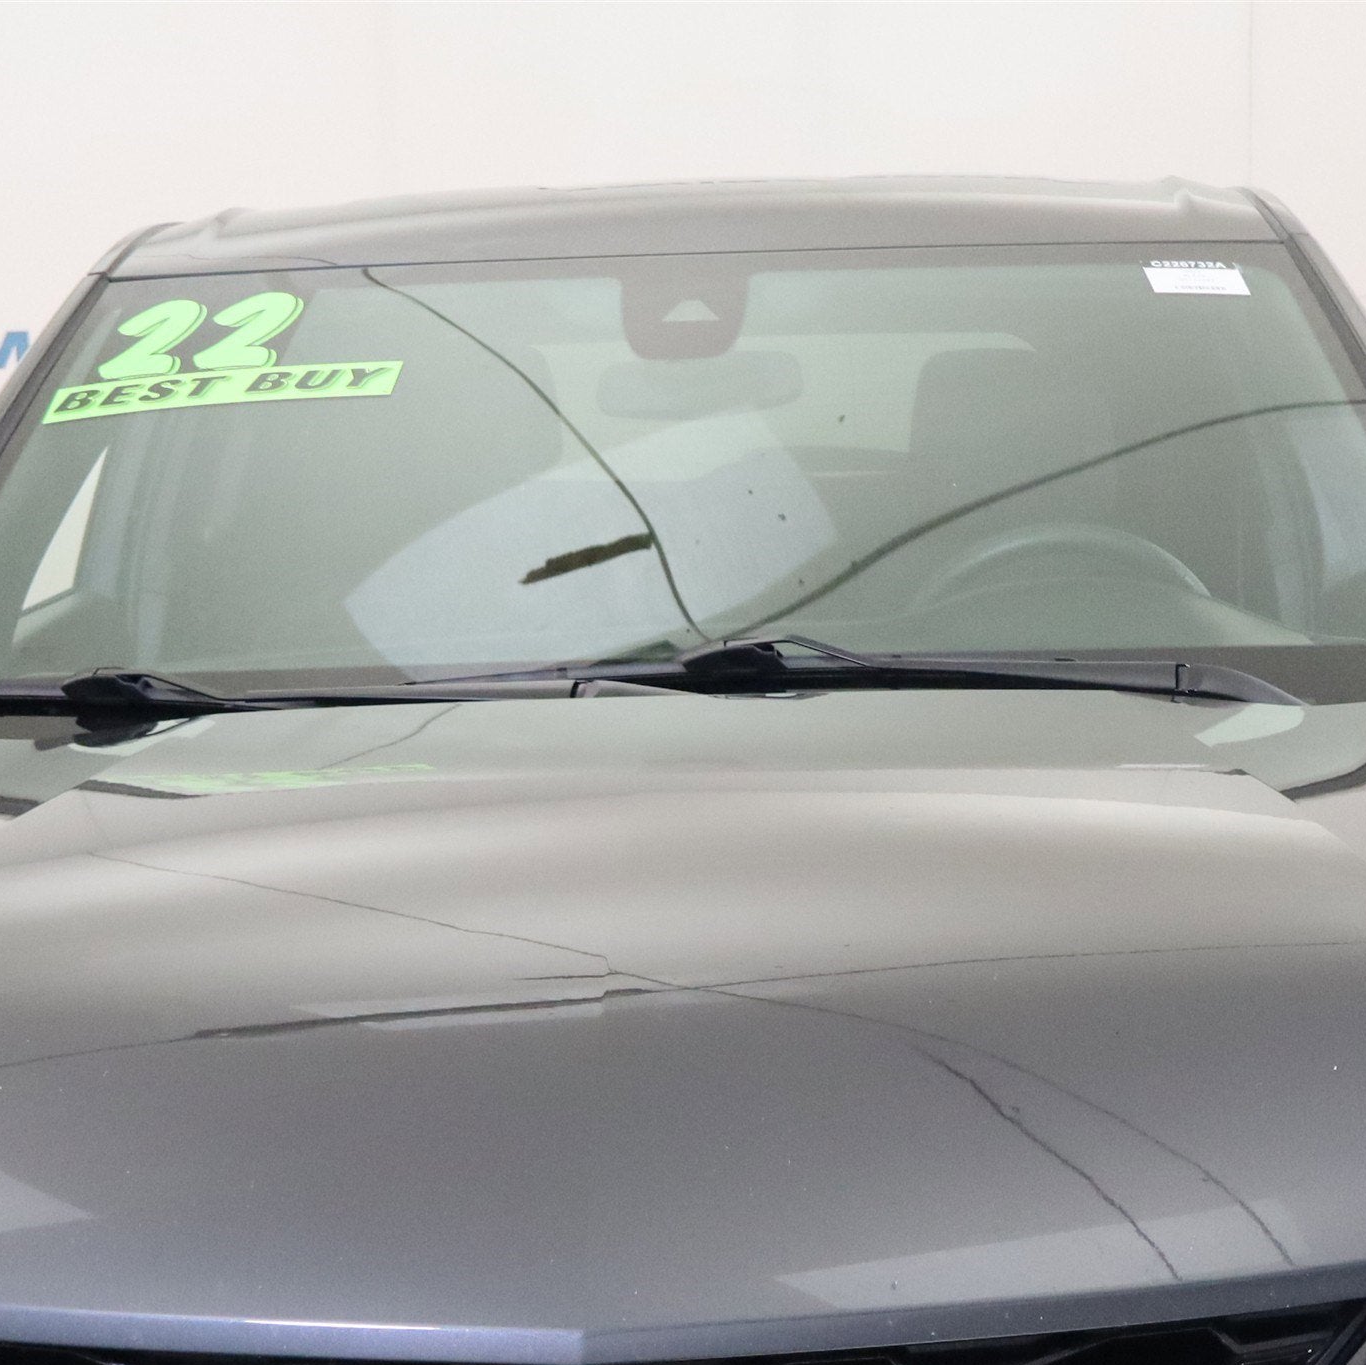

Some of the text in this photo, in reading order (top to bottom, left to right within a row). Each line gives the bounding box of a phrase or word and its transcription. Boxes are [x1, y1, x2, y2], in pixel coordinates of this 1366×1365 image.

[98, 292, 305, 381] 22
[53, 366, 388, 414] BEST BUY
